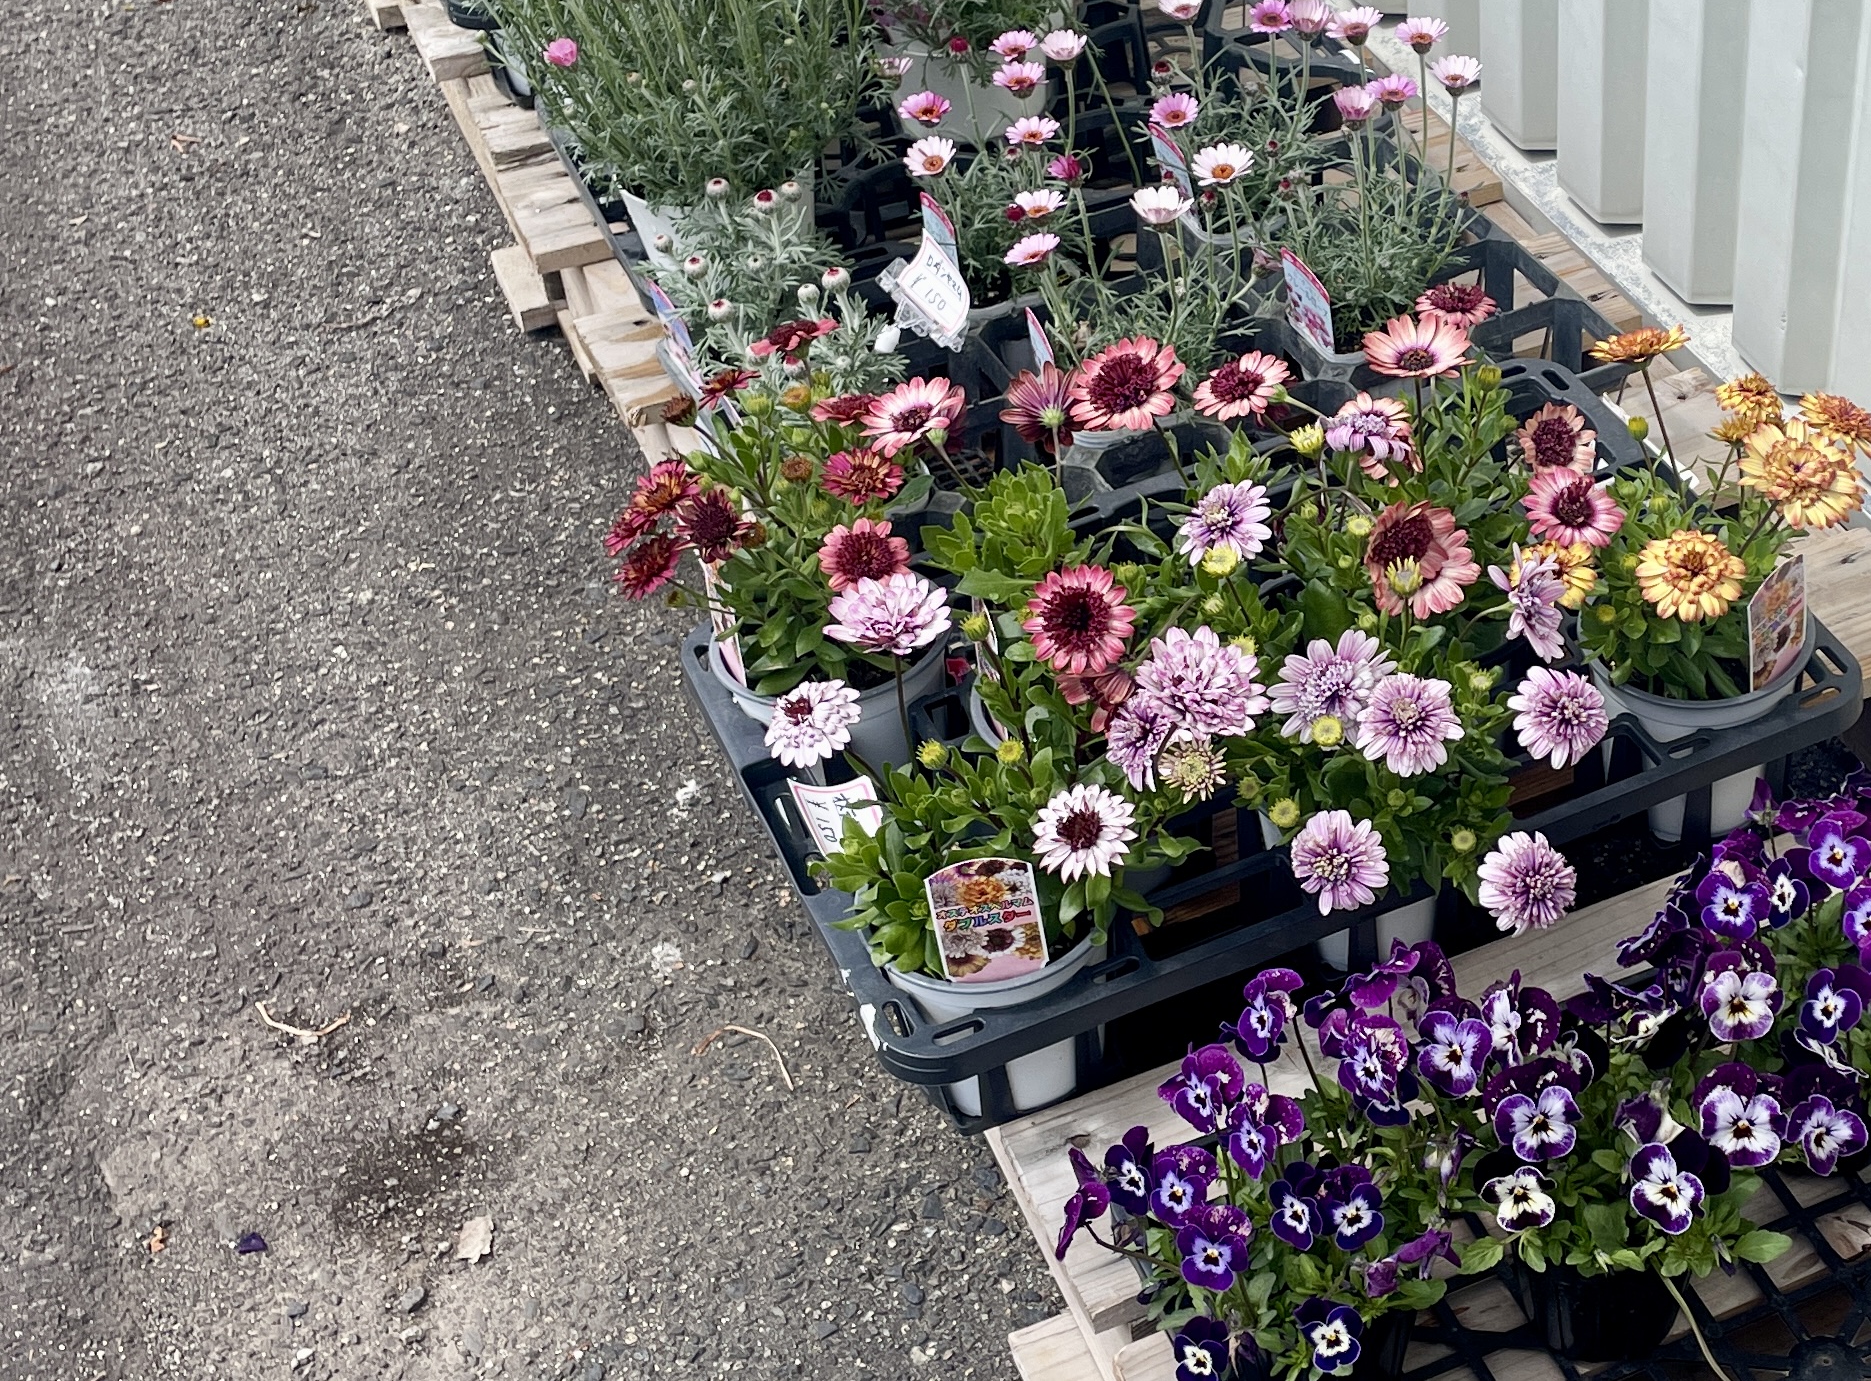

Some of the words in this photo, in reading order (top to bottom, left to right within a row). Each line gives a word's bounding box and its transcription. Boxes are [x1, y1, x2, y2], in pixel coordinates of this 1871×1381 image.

[942, 910, 1032, 933] ダブルスター
